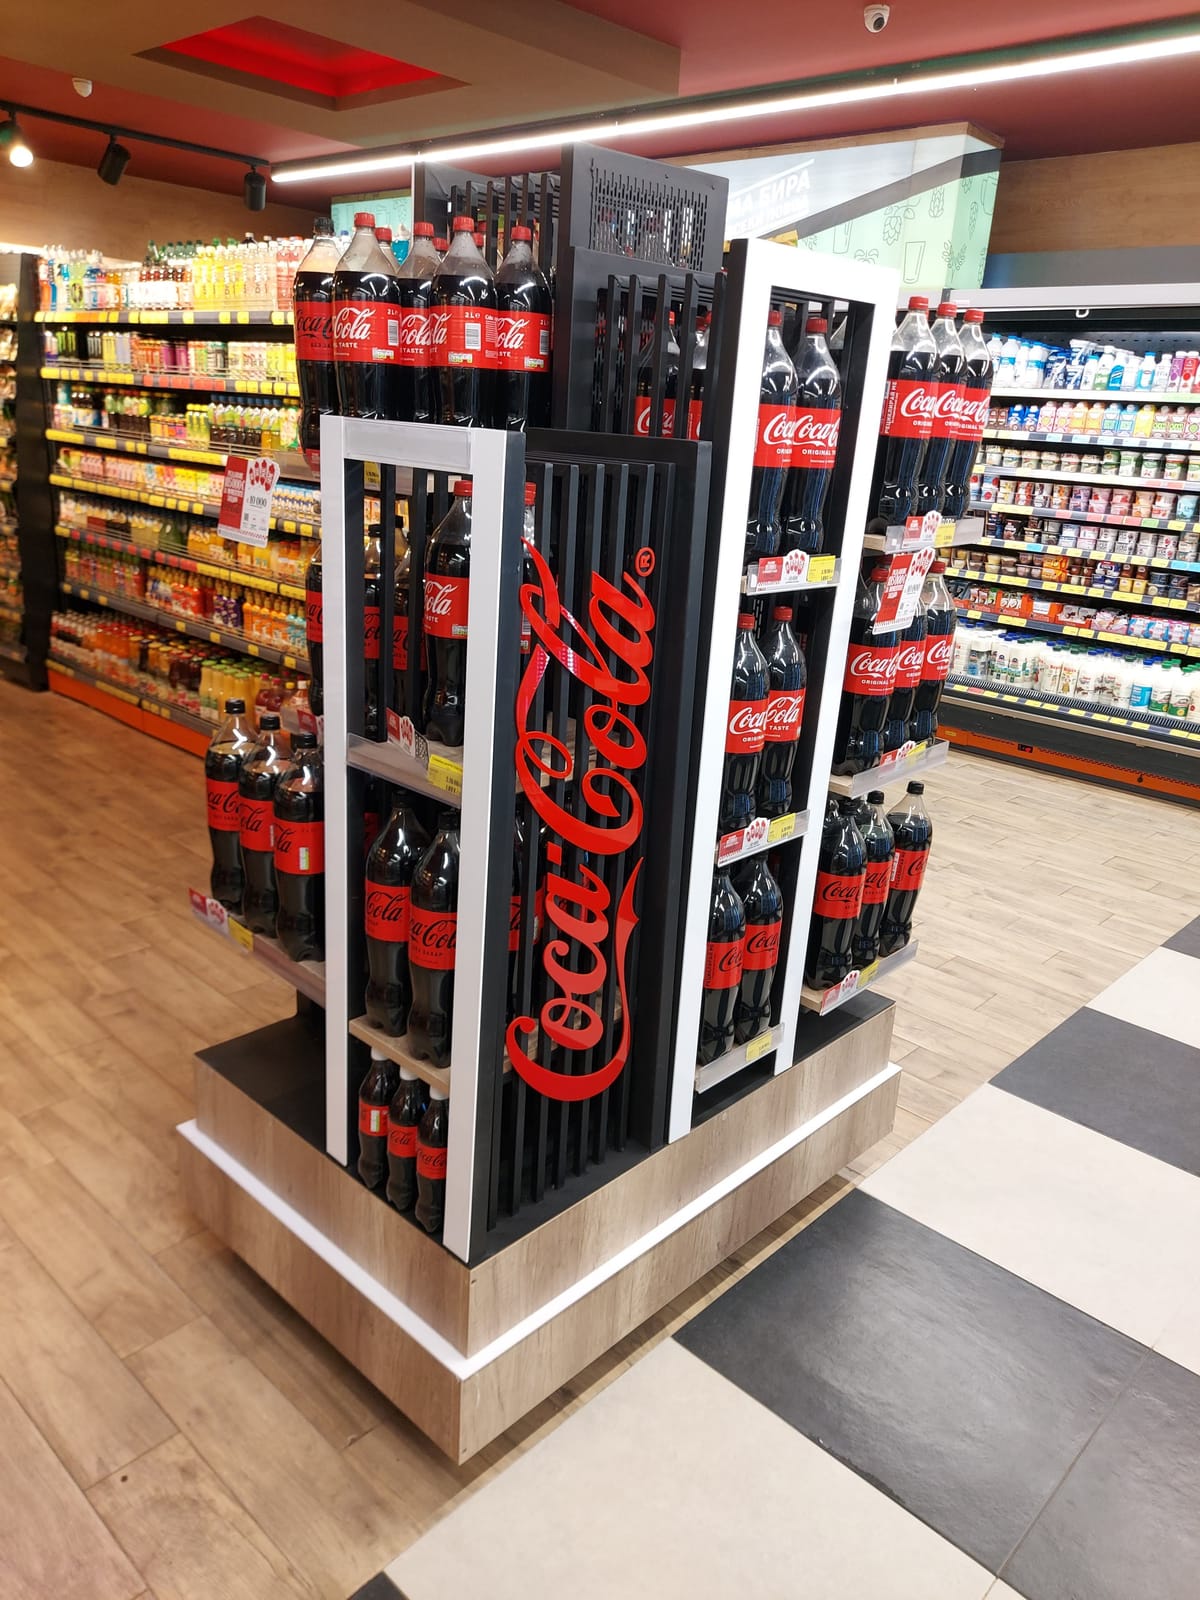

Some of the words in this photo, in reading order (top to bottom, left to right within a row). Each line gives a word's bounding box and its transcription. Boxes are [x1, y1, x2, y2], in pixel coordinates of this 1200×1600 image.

[759, 168, 811, 208] БИРА
[801, 448, 831, 456] ORIGINAL
[367, 891, 407, 922] Cola
